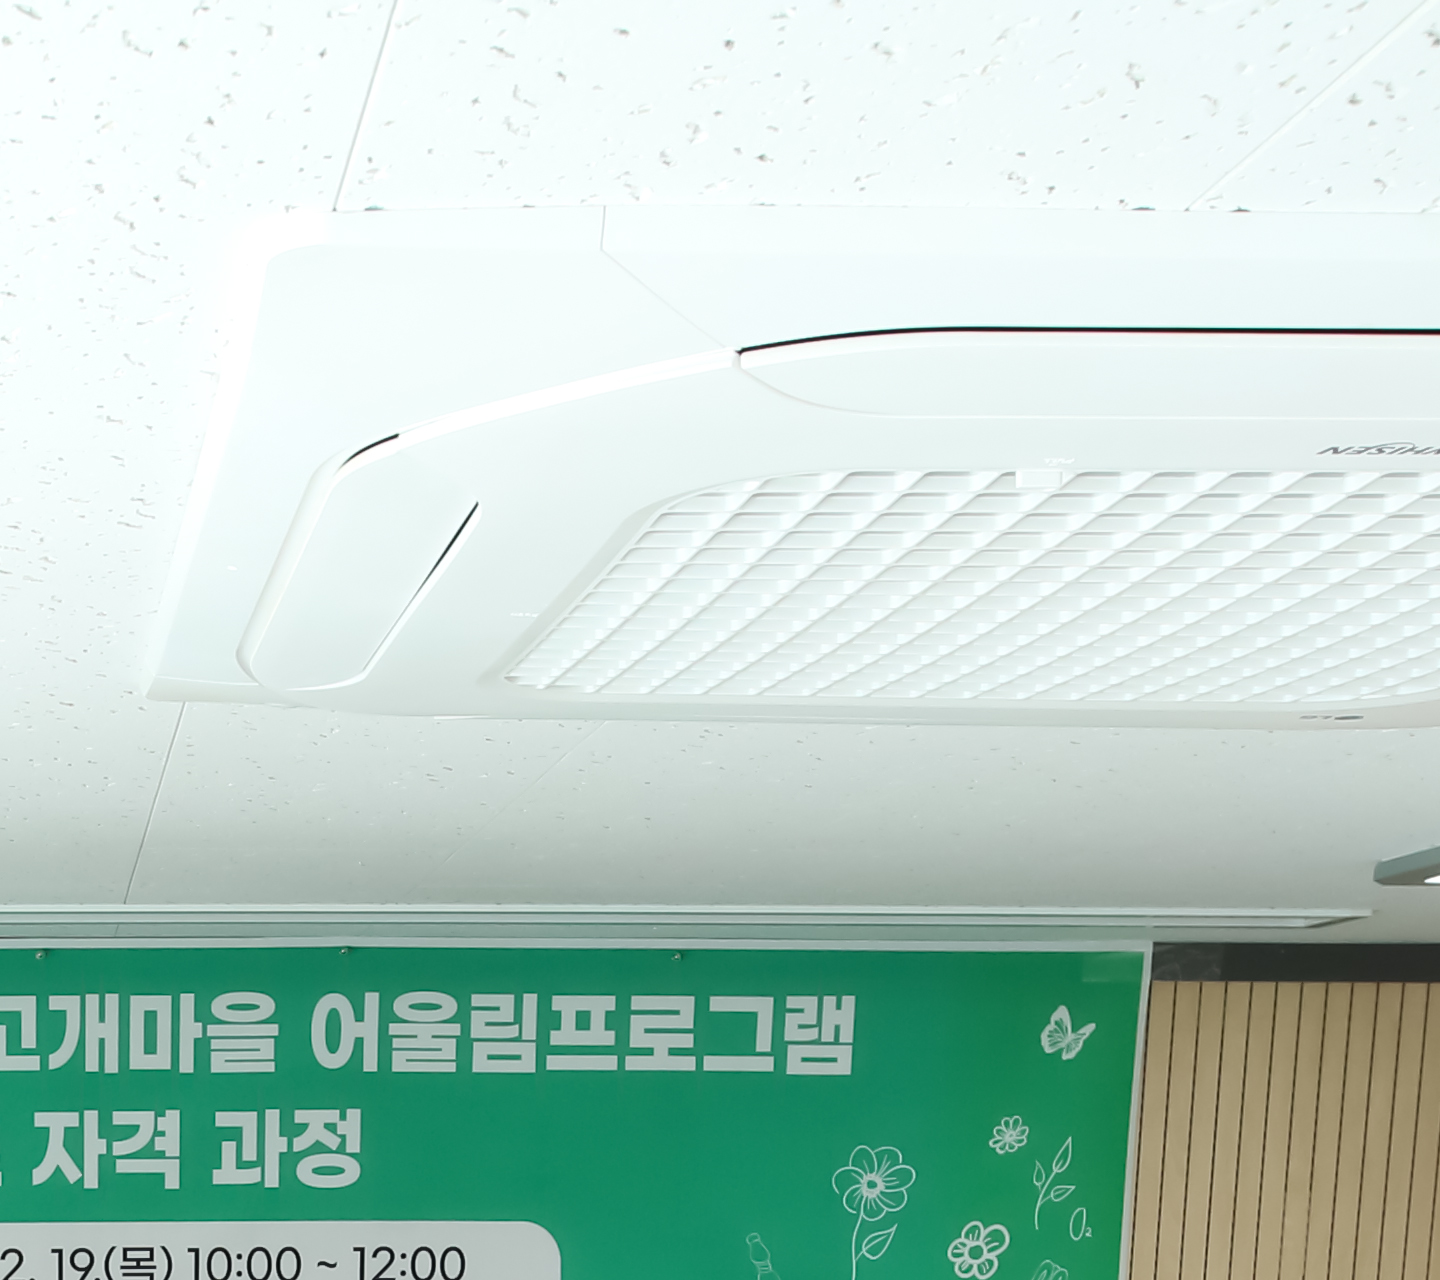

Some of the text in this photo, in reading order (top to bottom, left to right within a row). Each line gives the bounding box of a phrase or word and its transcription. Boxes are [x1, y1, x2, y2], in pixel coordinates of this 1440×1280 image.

[311, 991, 856, 1075] 어울림프로그램
[33, 1110, 180, 1189] 자격
[213, 1109, 362, 1188] 과정
